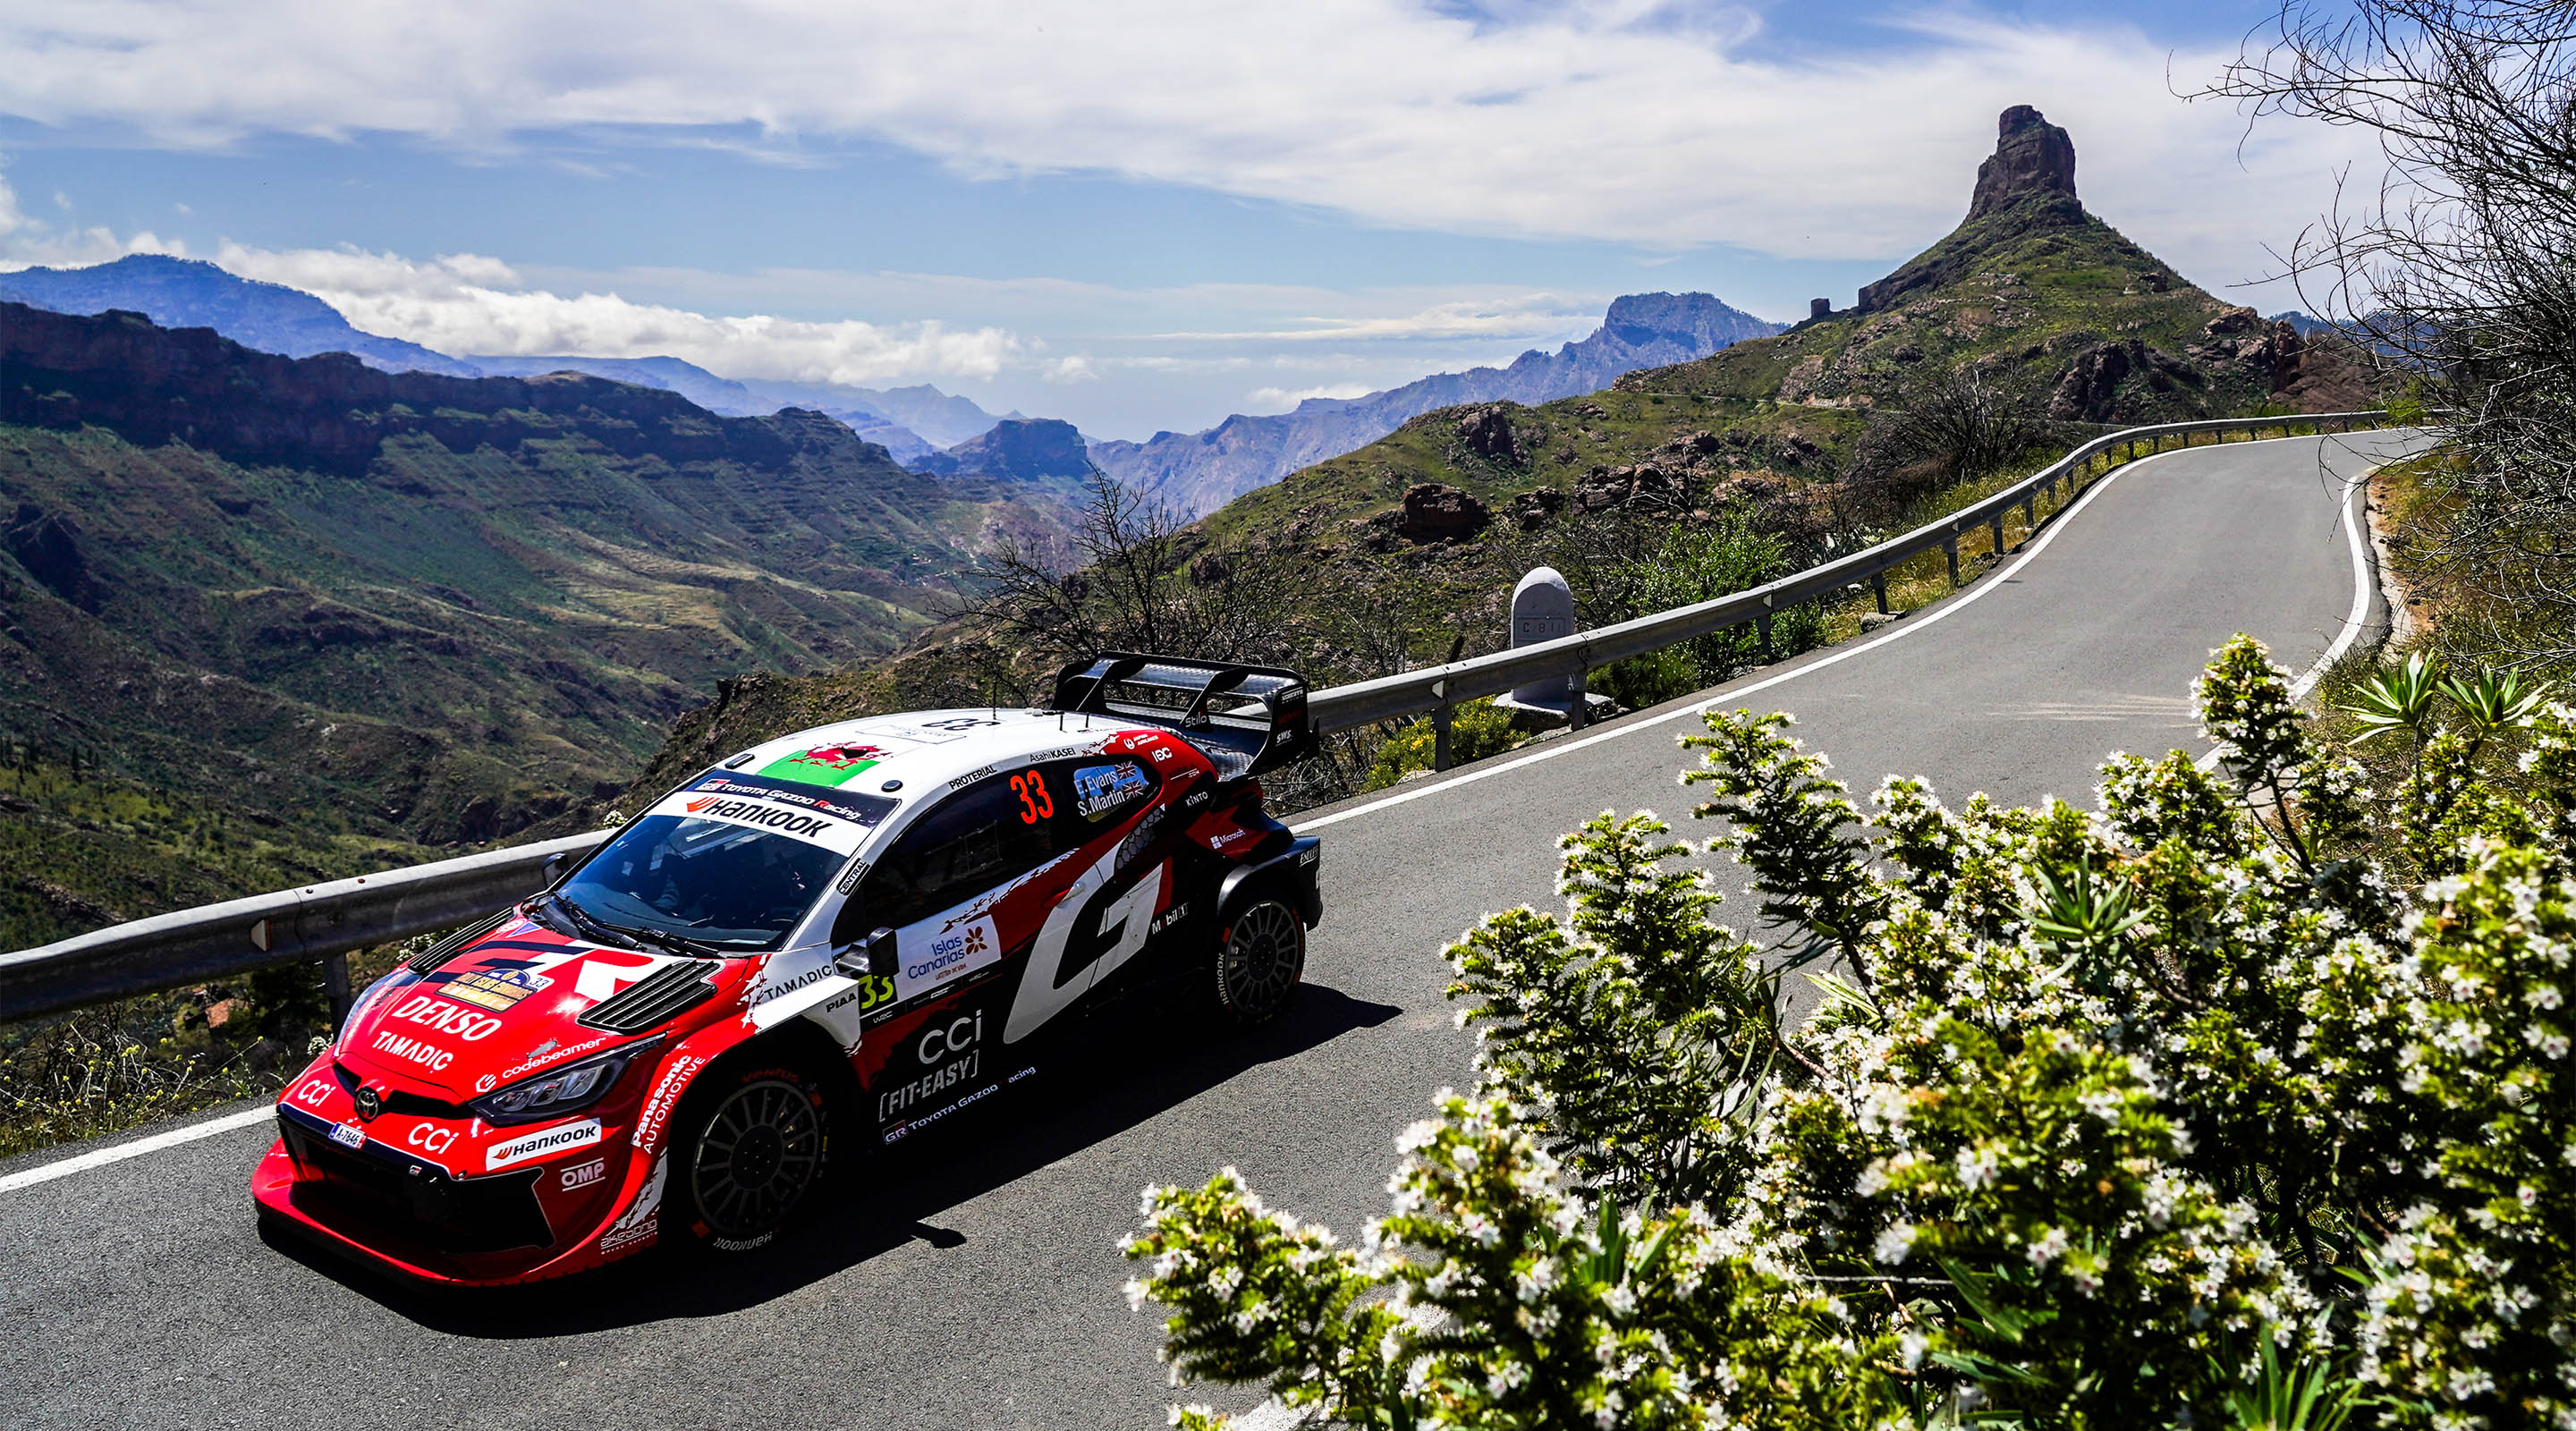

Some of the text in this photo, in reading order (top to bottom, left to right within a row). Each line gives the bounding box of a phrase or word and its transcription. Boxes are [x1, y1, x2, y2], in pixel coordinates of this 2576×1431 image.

[1185, 712, 1208, 728] Stilo
[948, 765, 997, 790] PROTERIAL
[722, 783, 767, 795] TOYOTA
[813, 800, 862, 820] Racing
[1010, 770, 1055, 825] 33
[838, 860, 867, 894] CENTRAL
[908, 949, 965, 979] Canarias
[931, 936, 962, 956] Islas
[530, 977, 550, 988] 33
[764, 964, 833, 1001] TAMADIC
[391, 995, 503, 1041] DENSO
[826, 993, 857, 1012] PIAA
[371, 1031, 454, 1072] TAMADIC
[502, 1037, 605, 1079] codebeamer
[630, 1055, 692, 1147] Panasonic
[643, 1056, 707, 1155] AUTOMOTIVE
[886, 1066, 1038, 1143] GR TOYOTA GAZOO acing
[561, 1162, 605, 1187] OMP
